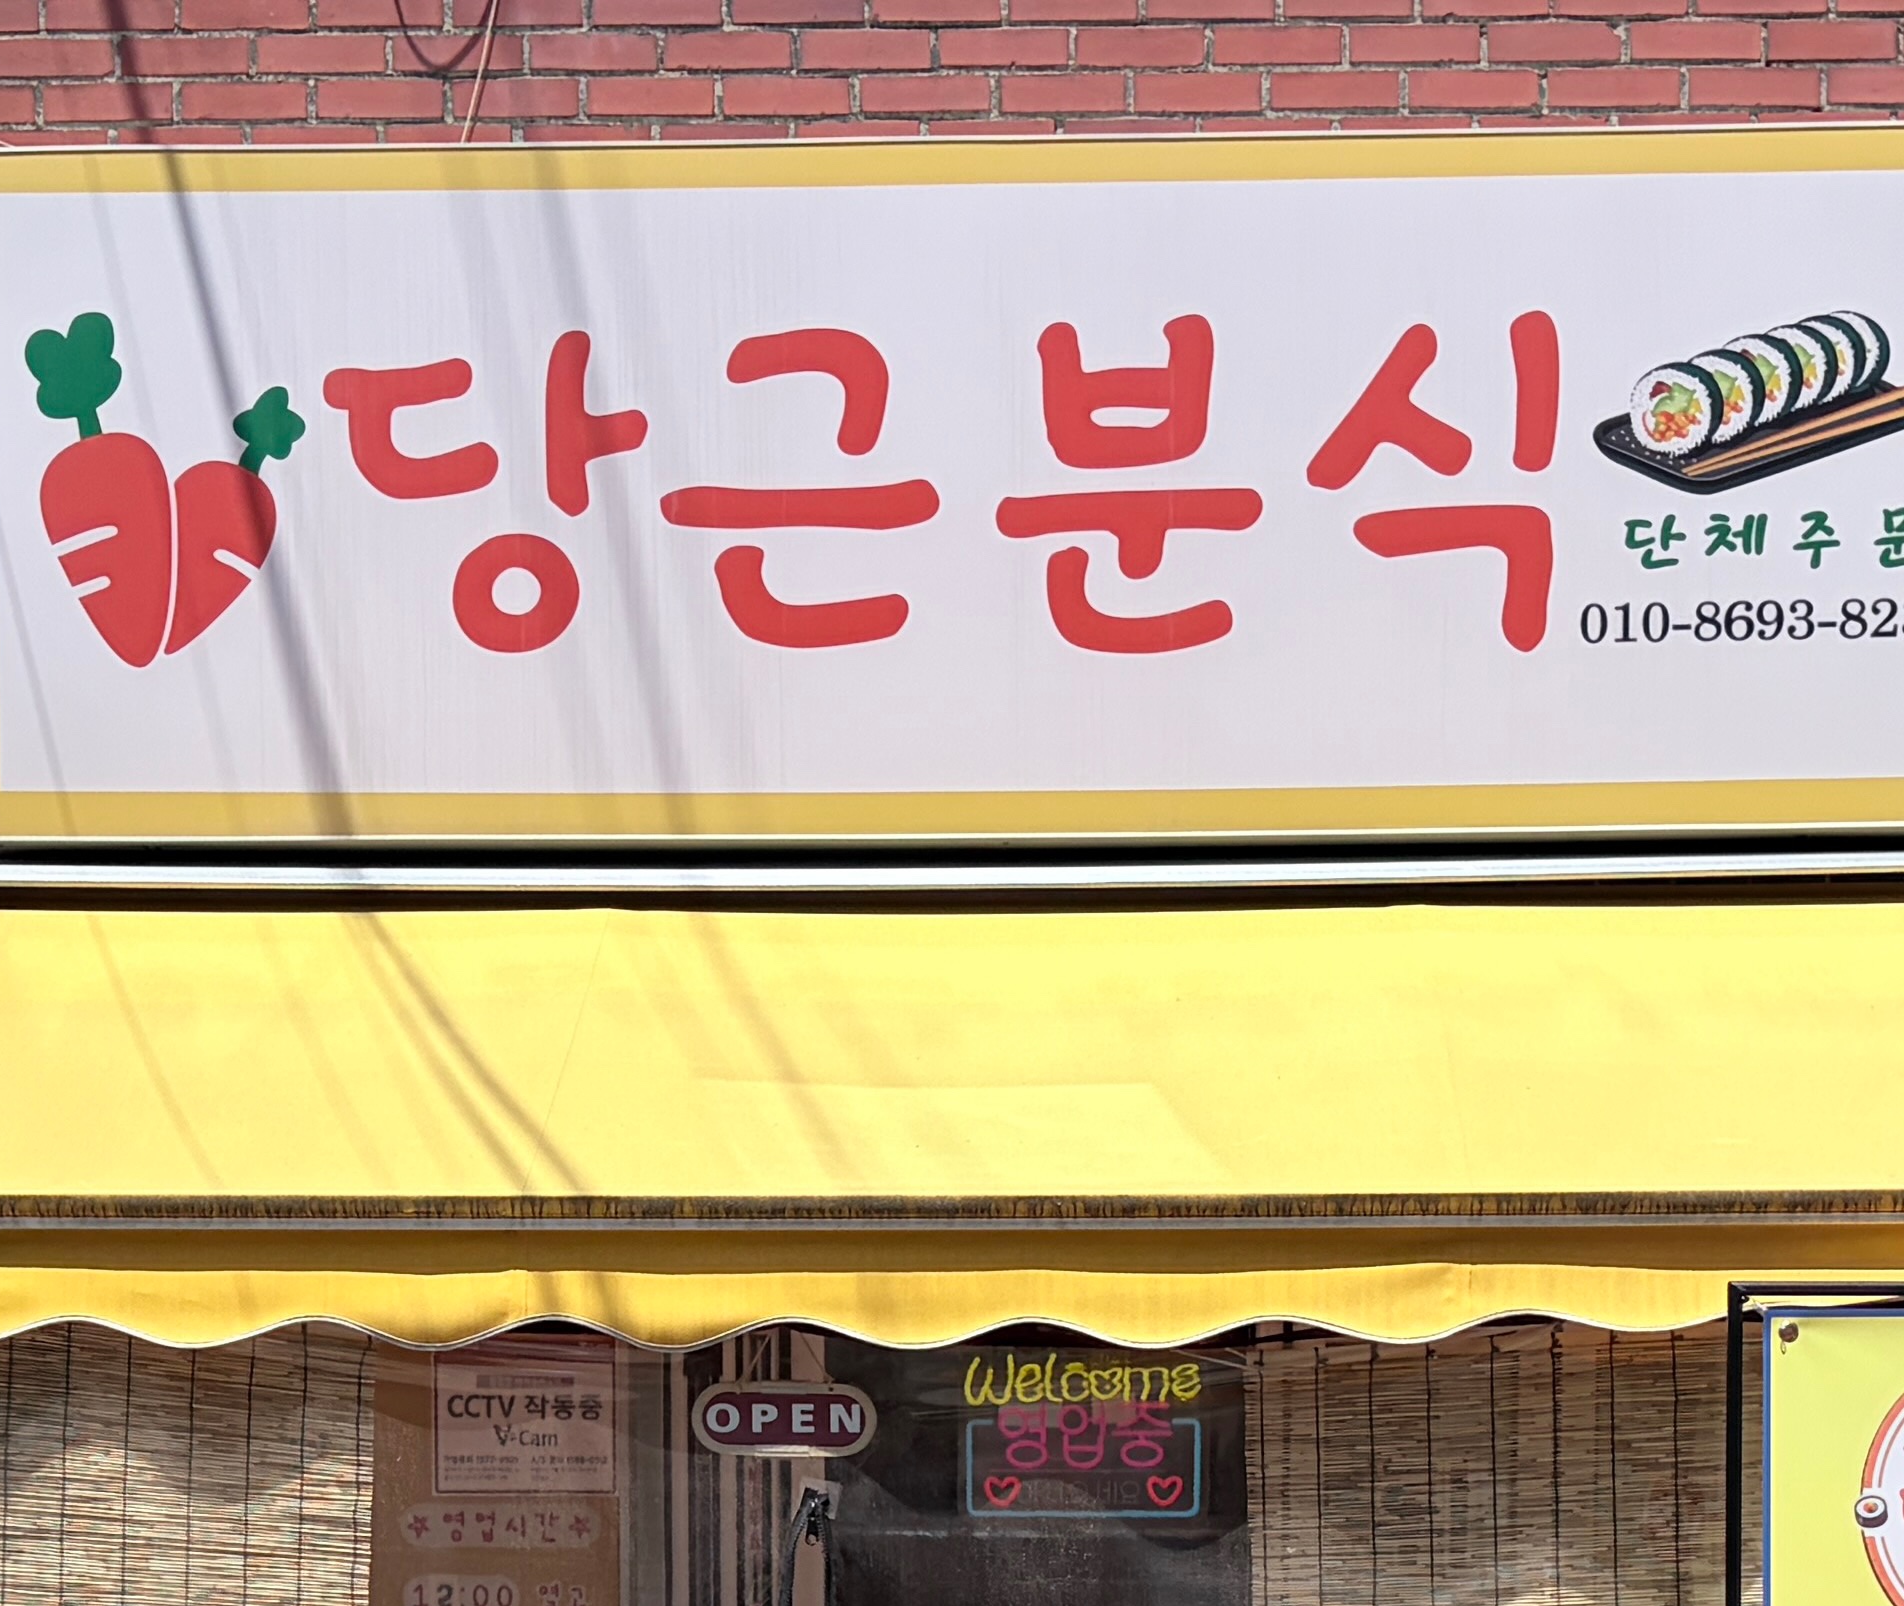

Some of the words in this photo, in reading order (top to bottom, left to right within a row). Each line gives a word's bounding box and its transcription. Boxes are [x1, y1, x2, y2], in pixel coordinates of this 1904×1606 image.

[323, 309, 1560, 654] 당근분식
[964, 1353, 1202, 1407] Welcome
[447, 1394, 516, 1419] CCTV
[524, 1393, 603, 1421] 작동중
[705, 1402, 862, 1434] OPEN
[997, 1401, 1174, 1470] 영업중
[442, 1510, 561, 1543] 영업시간
